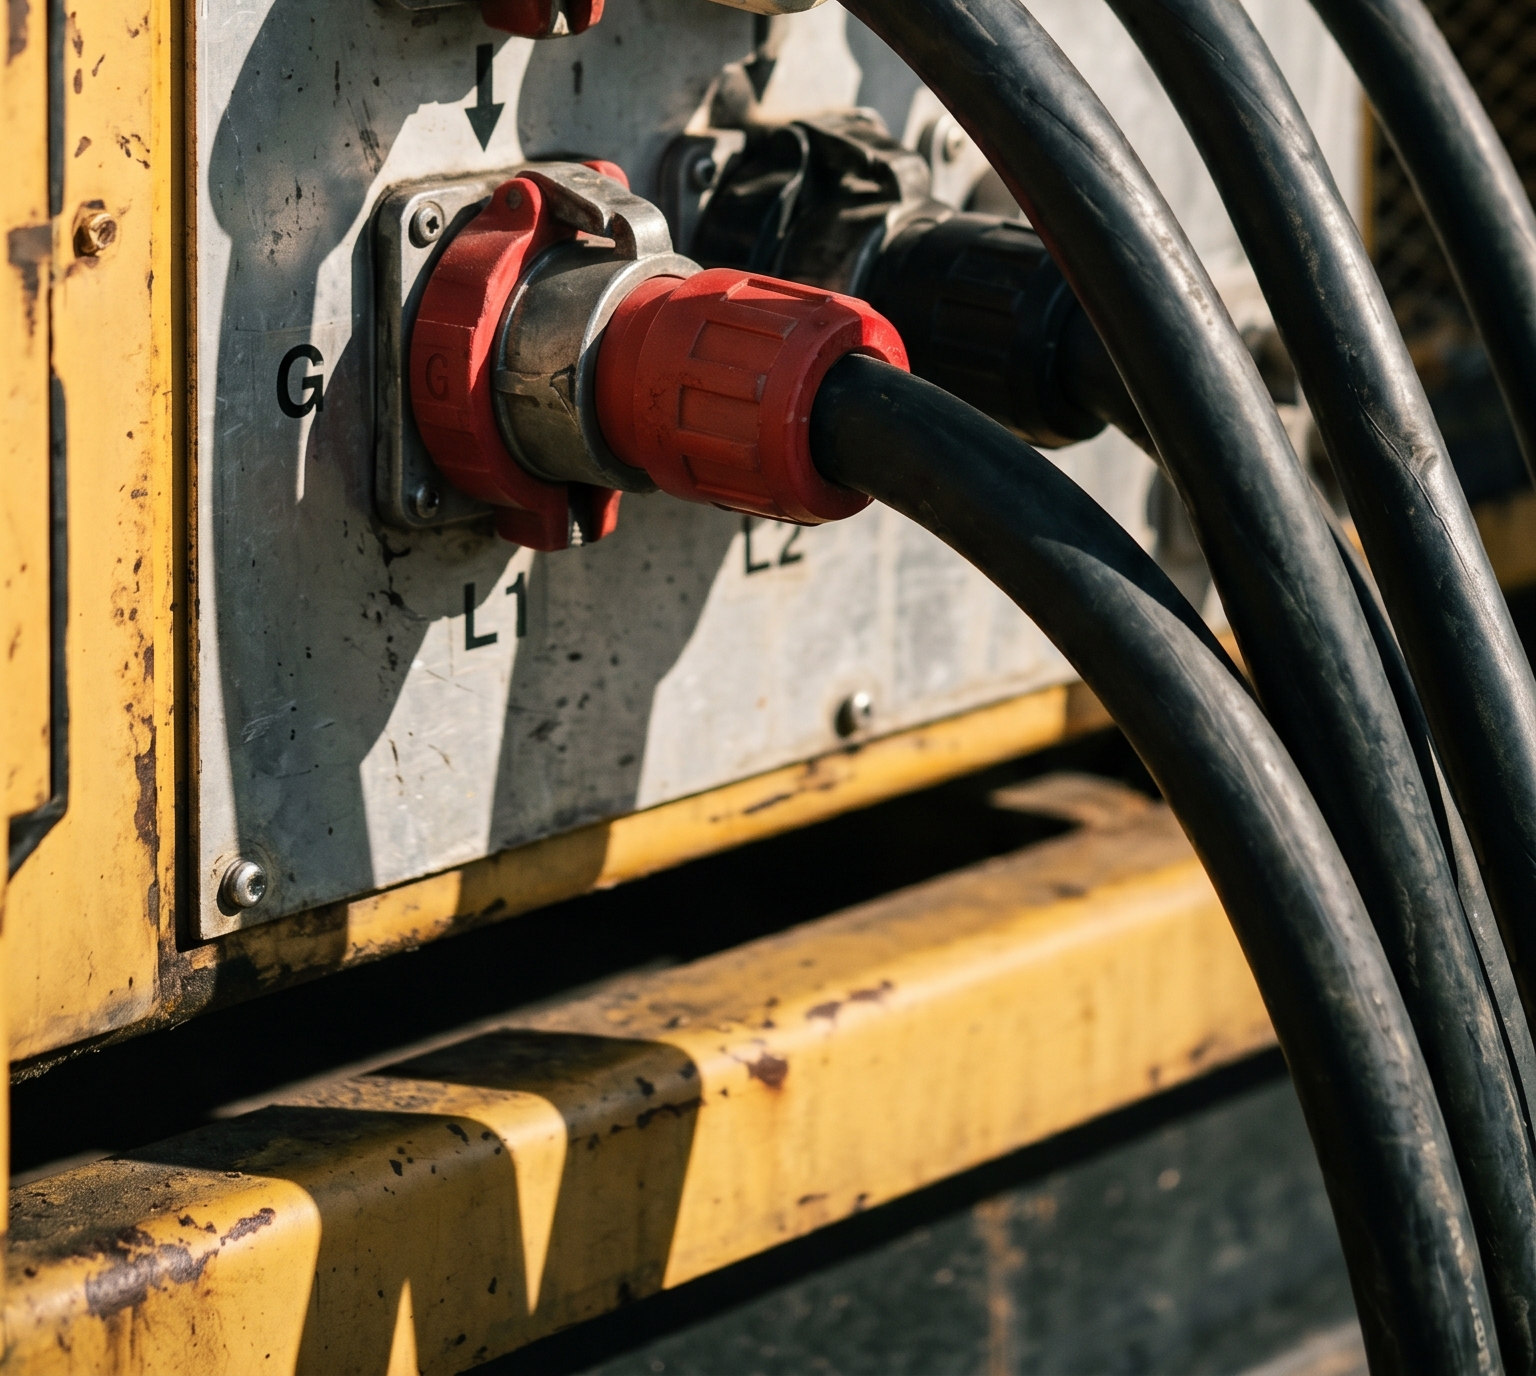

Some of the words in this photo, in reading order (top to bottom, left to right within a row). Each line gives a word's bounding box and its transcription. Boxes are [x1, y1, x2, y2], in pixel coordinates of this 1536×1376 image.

[276, 344, 324, 419] G
[425, 353, 449, 401] G
[463, 572, 528, 651] L1
